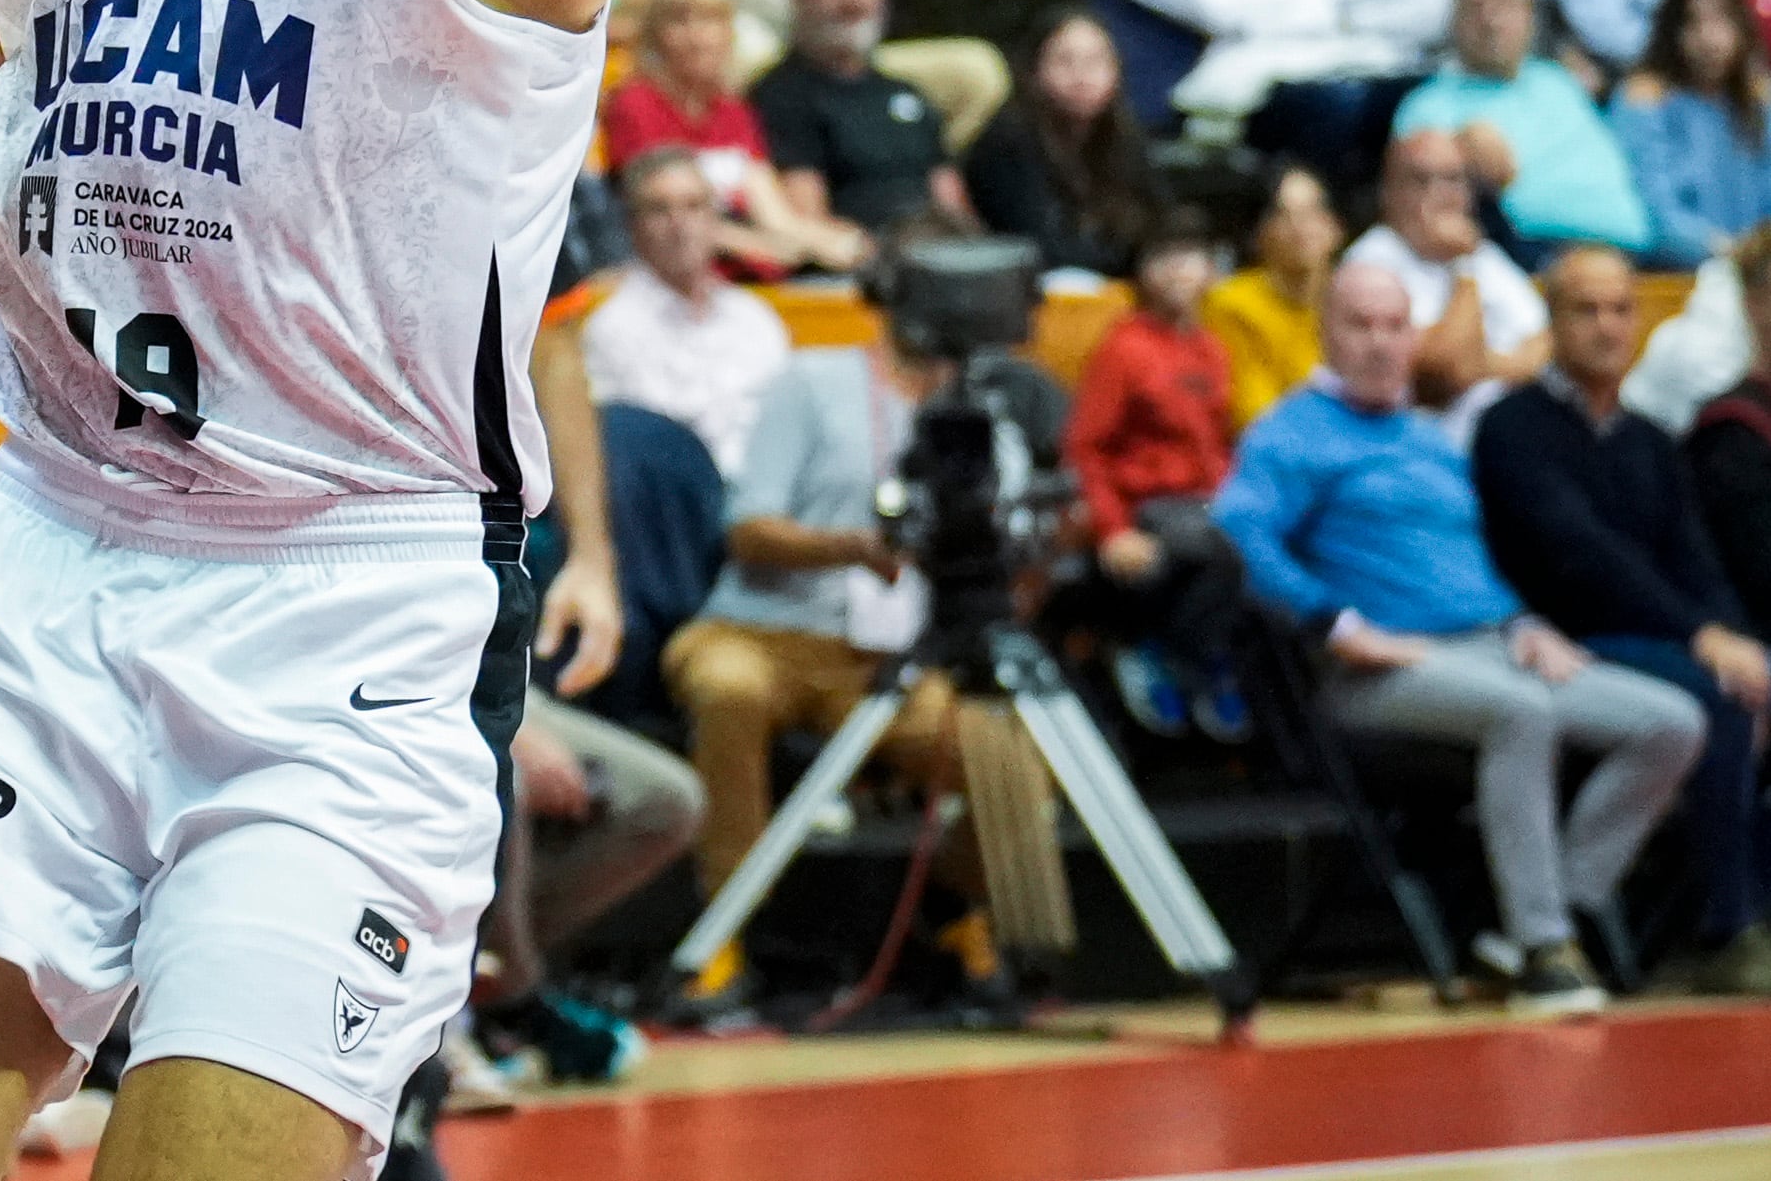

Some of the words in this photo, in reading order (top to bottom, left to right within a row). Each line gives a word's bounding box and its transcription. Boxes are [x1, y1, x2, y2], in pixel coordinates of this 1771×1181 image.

[25, 100, 241, 187] MURCIA
[74, 182, 185, 209] CARAVACA
[74, 209, 98, 227] DE
[104, 213, 125, 229] LA
[130, 213, 179, 236] CRUZ
[184, 218, 234, 242] 2024
[70, 232, 117, 256] AÑO
[122, 237, 193, 264] JUBILAR
[360, 927, 396, 963] acb
